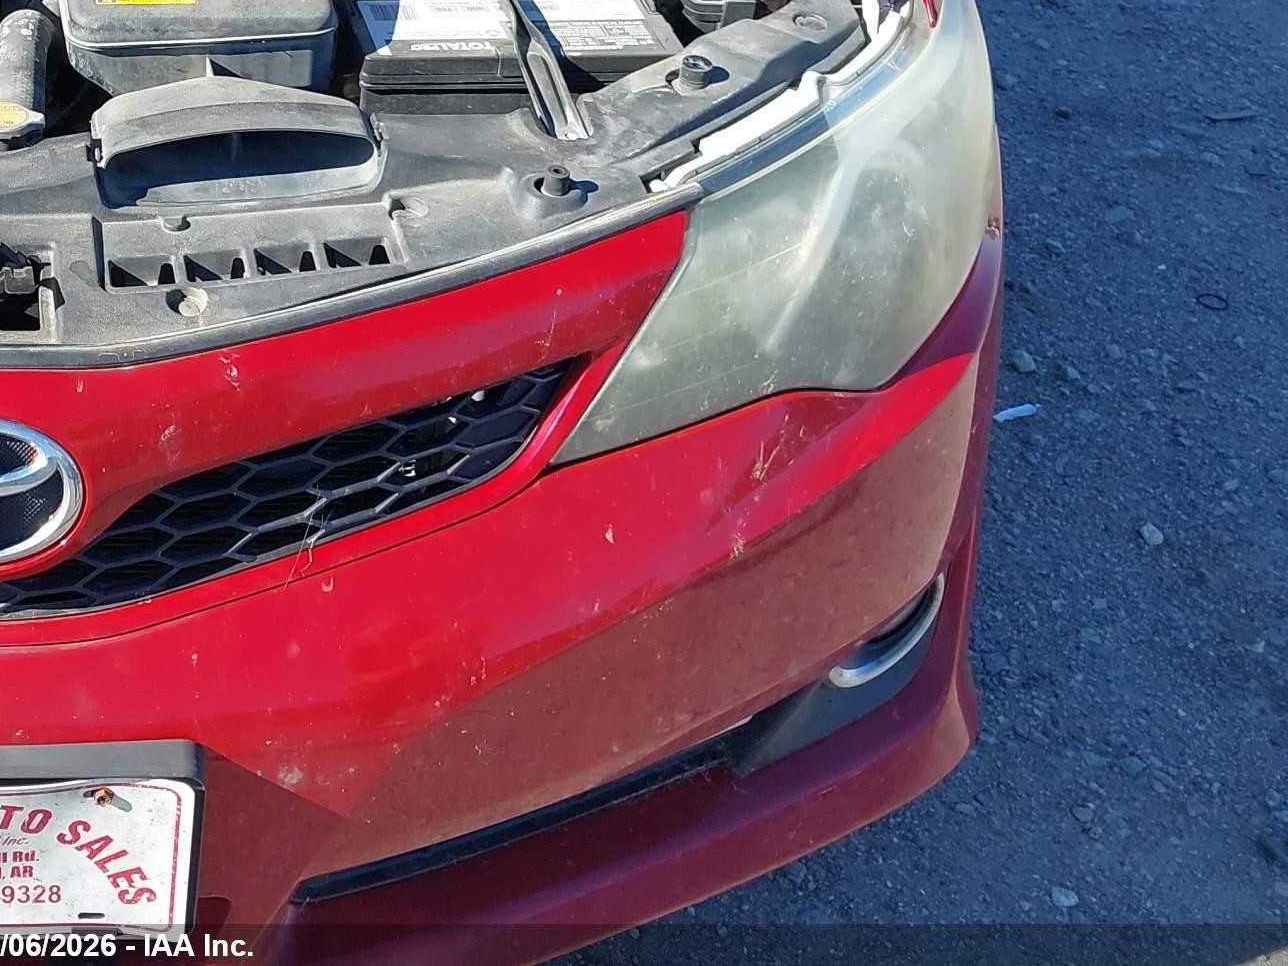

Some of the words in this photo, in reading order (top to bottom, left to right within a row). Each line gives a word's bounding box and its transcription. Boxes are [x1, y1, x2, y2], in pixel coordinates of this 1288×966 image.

[2, 836, 30, 846] Inc.
[12, 850, 40, 863] Rd.
[56, 819, 157, 905] SALES
[10, 865, 34, 879] AR
